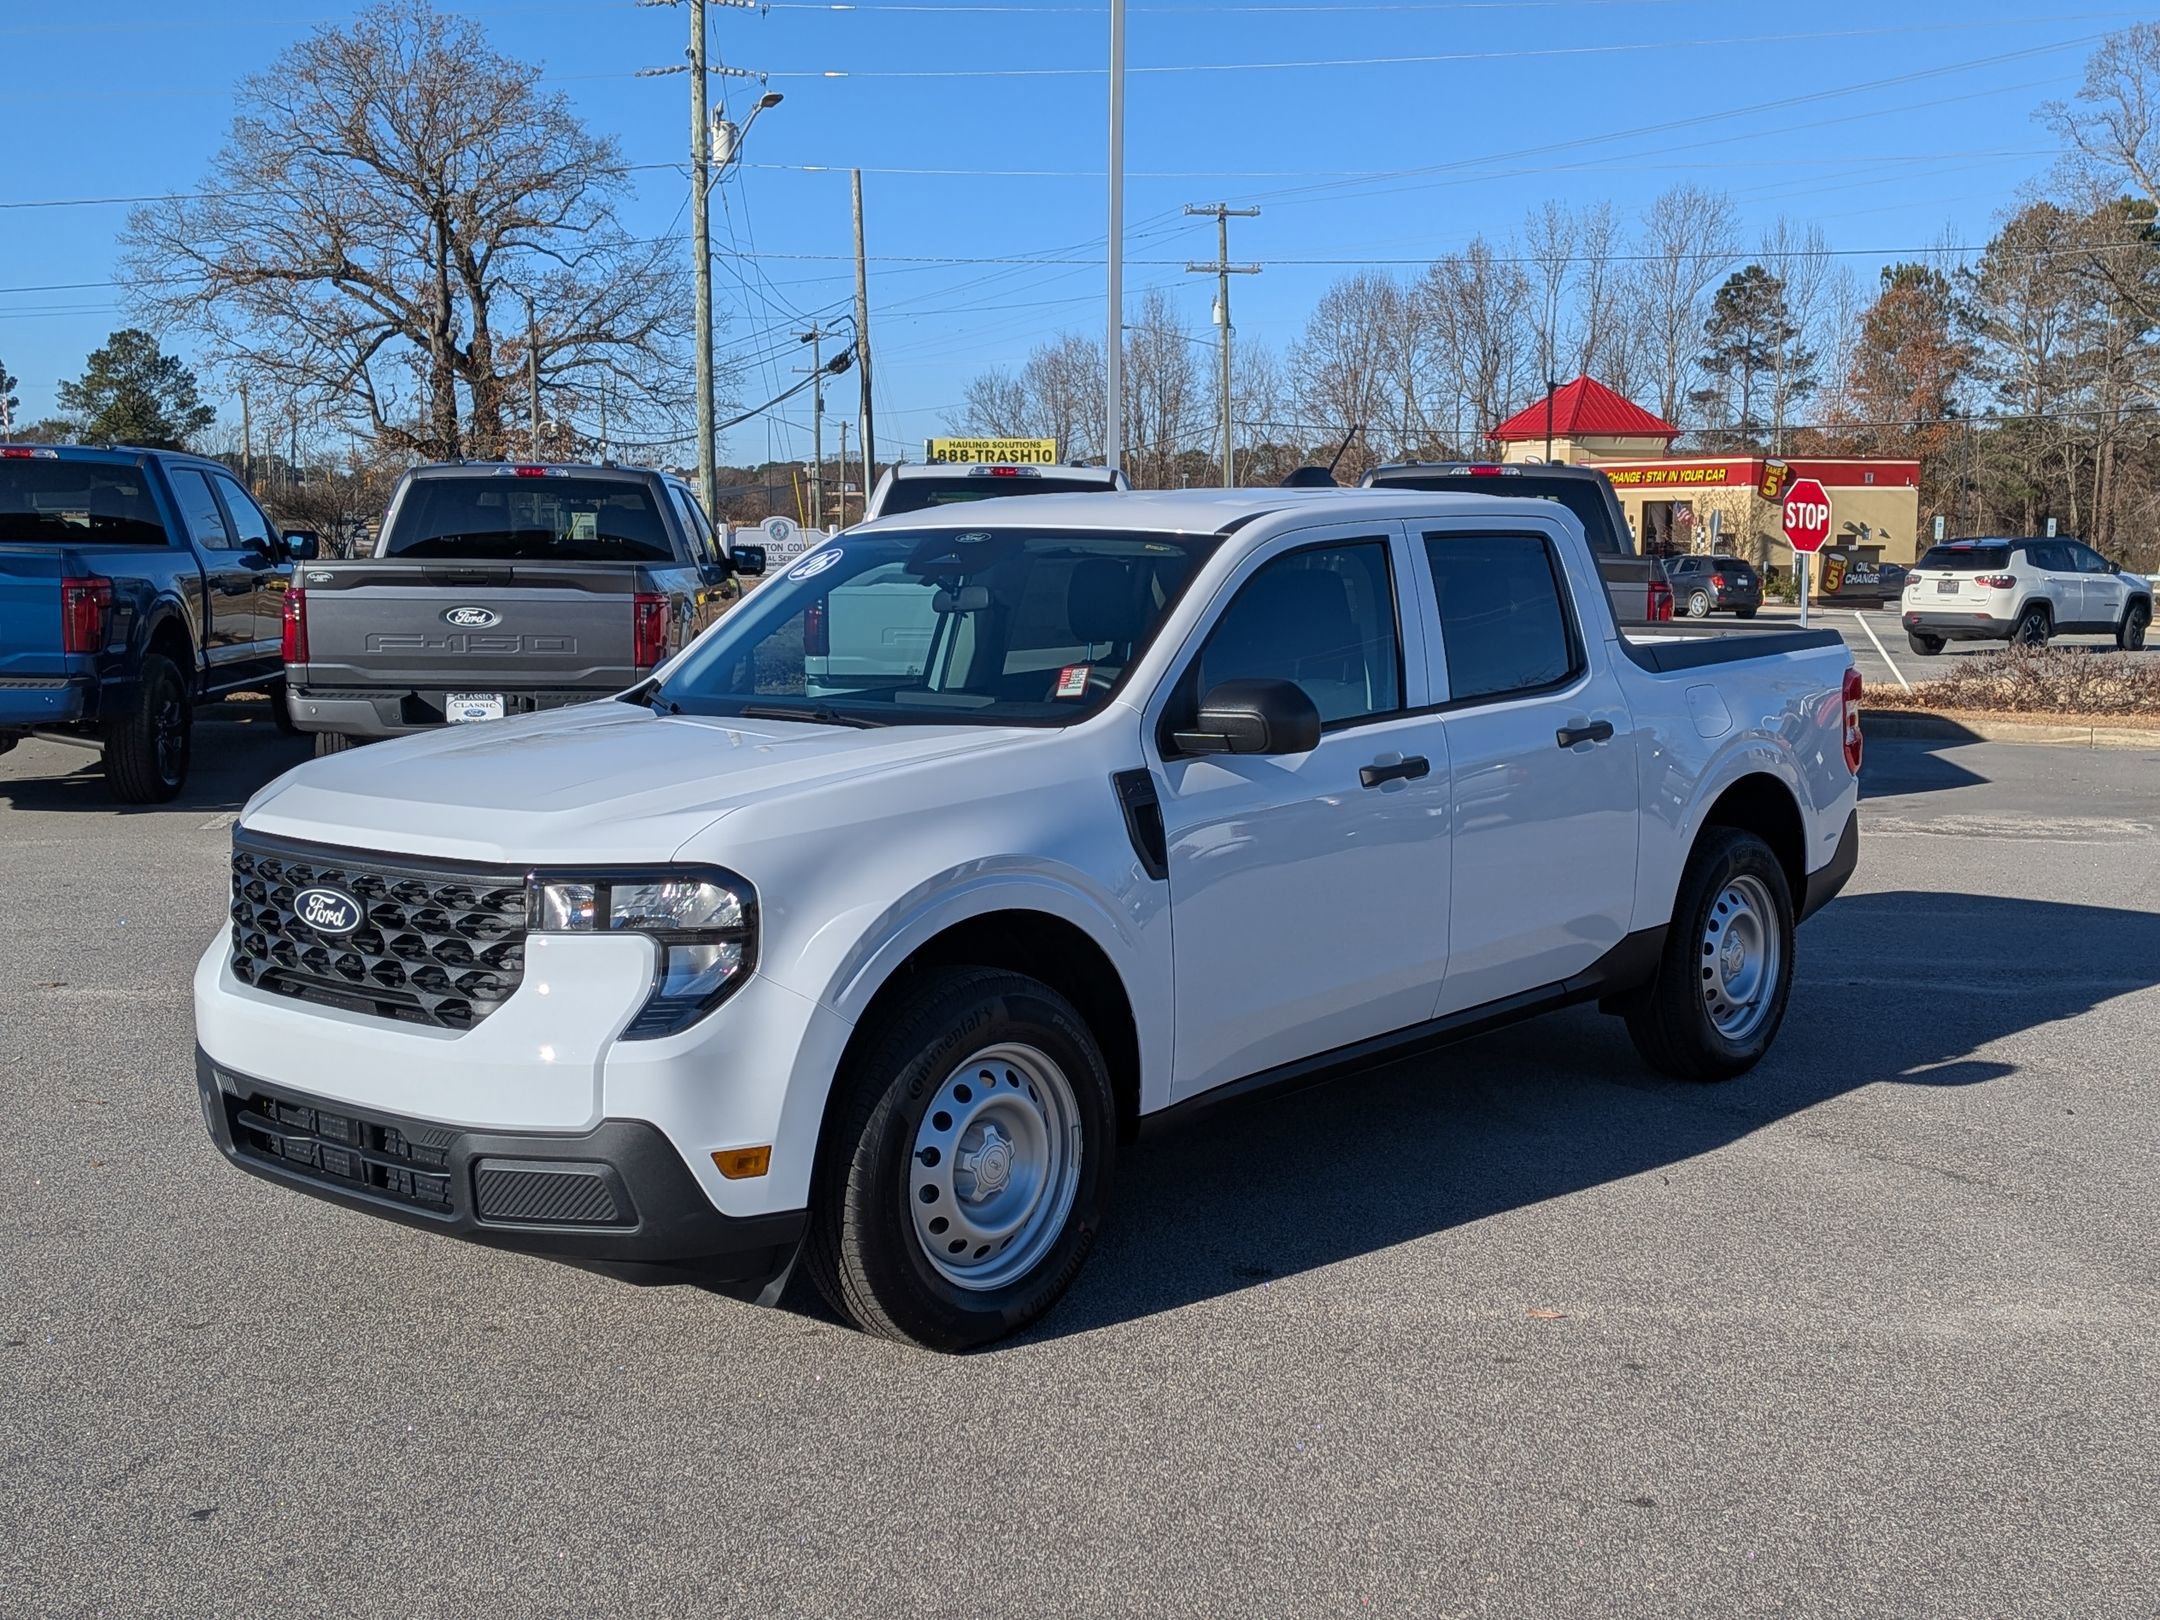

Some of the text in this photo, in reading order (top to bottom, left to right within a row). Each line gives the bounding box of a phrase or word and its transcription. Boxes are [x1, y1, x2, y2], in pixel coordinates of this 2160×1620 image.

[938, 449, 1053, 463] 888-TRASH10
[1646, 470, 1667, 482] STAY
[1668, 469, 1678, 481] IN
[1680, 469, 1704, 481] YOUR
[1705, 468, 1726, 481] CAR
[1765, 465, 1782, 475] TAKE
[1763, 476, 1778, 496] 5
[1785, 502, 1829, 531] STOP
[1856, 561, 1870, 573] OIL
[1825, 569, 1839, 590] 5
[1845, 573, 1880, 585] CHANGE
[455, 609, 486, 624] Ford
[366, 633, 578, 655] F-150
[306, 894, 346, 927] Ford
